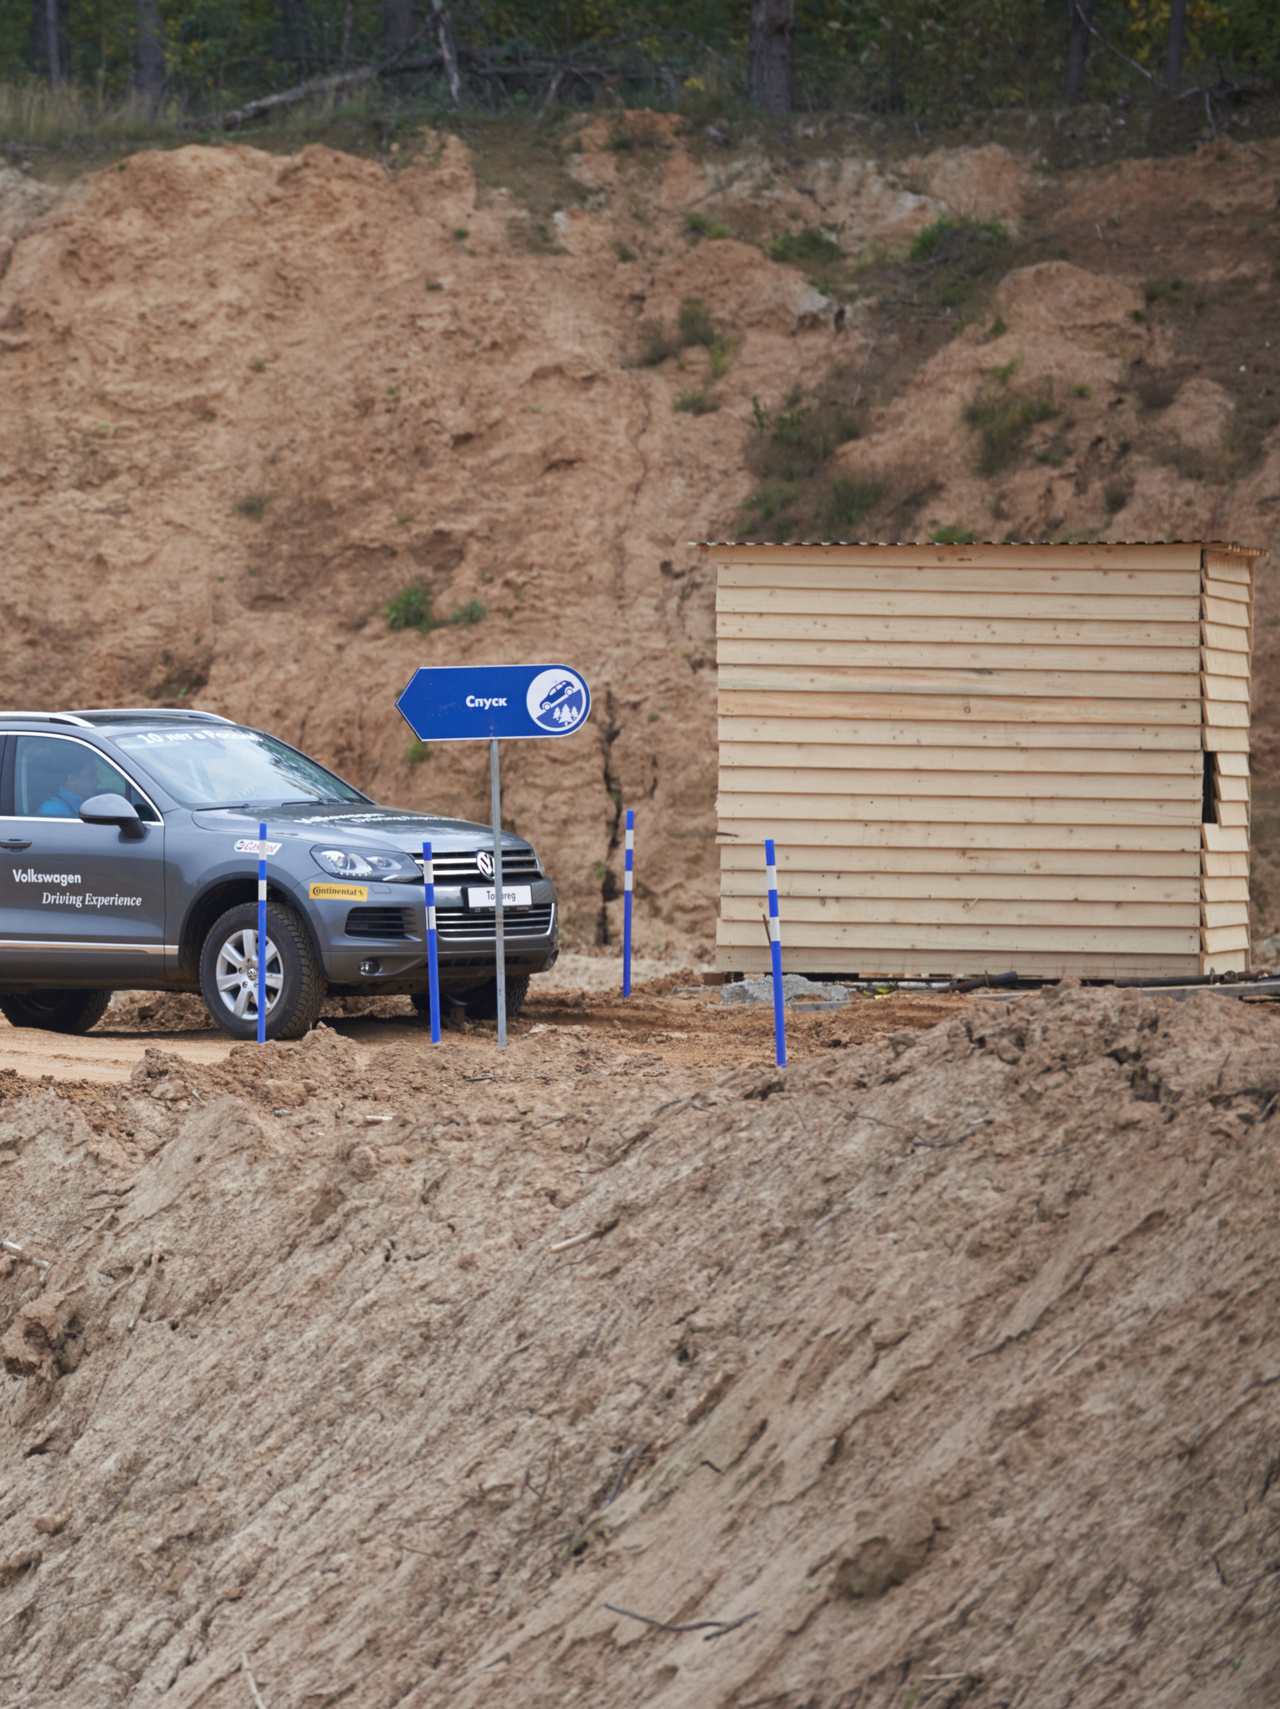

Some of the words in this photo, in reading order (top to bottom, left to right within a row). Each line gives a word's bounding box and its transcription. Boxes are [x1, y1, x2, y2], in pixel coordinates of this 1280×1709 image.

[465, 695, 508, 710] Спуск
[137, 732, 164, 744] 10
[244, 841, 278, 854] Casol
[12, 868, 82, 887] Volkswagen
[312, 885, 357, 897] Continental
[486, 890, 517, 903] Toareg
[41, 892, 83, 909] Driving
[84, 893, 143, 909] Experience
